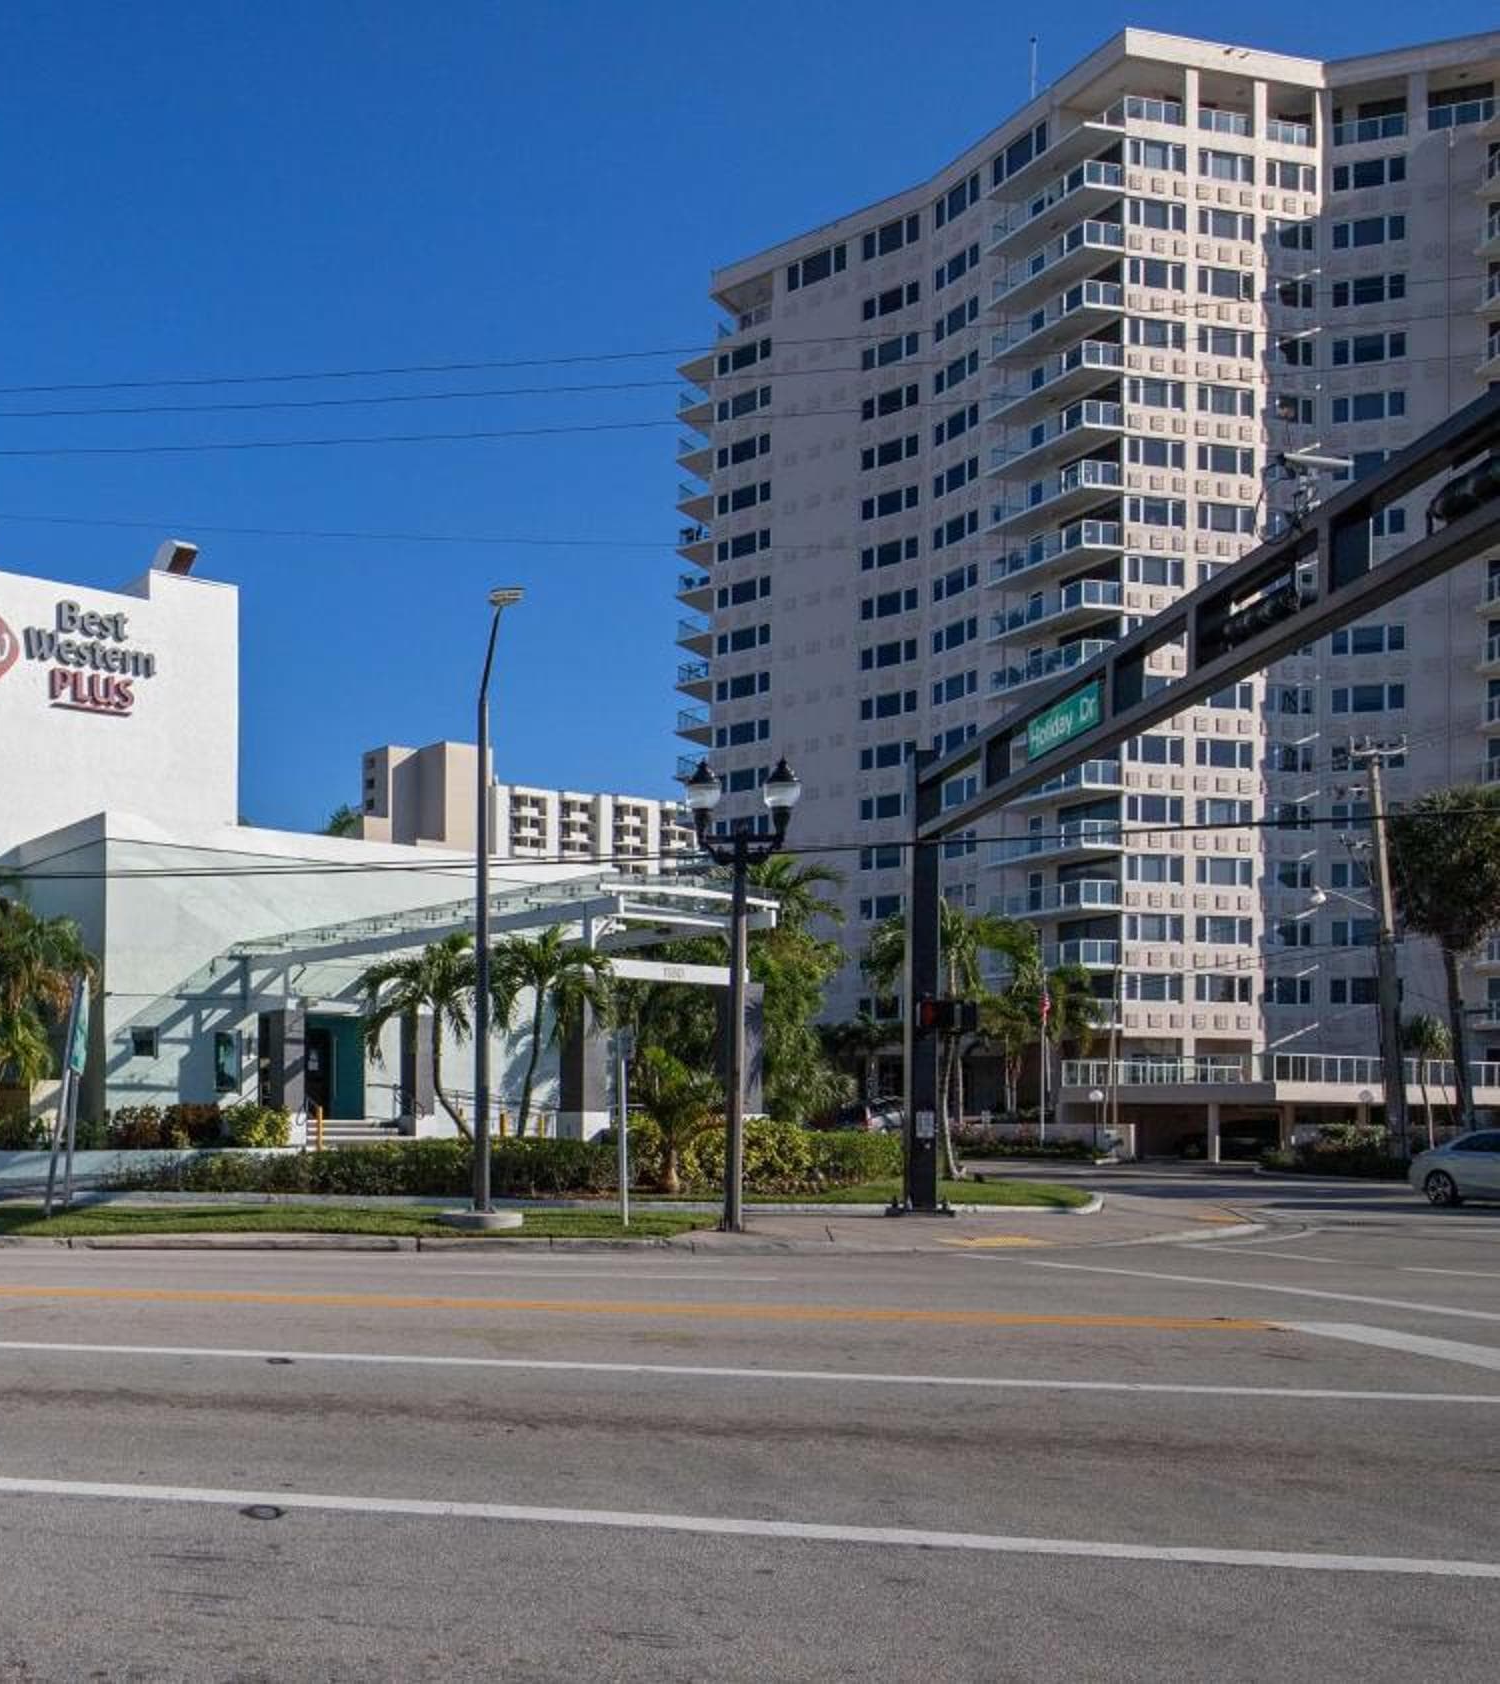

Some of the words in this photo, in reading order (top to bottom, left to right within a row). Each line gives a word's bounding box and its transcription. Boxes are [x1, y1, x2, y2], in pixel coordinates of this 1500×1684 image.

[55, 600, 128, 642] Best
[23, 626, 157, 678] Western
[49, 668, 134, 710] PLUS
[1080, 697, 1096, 721] Dr
